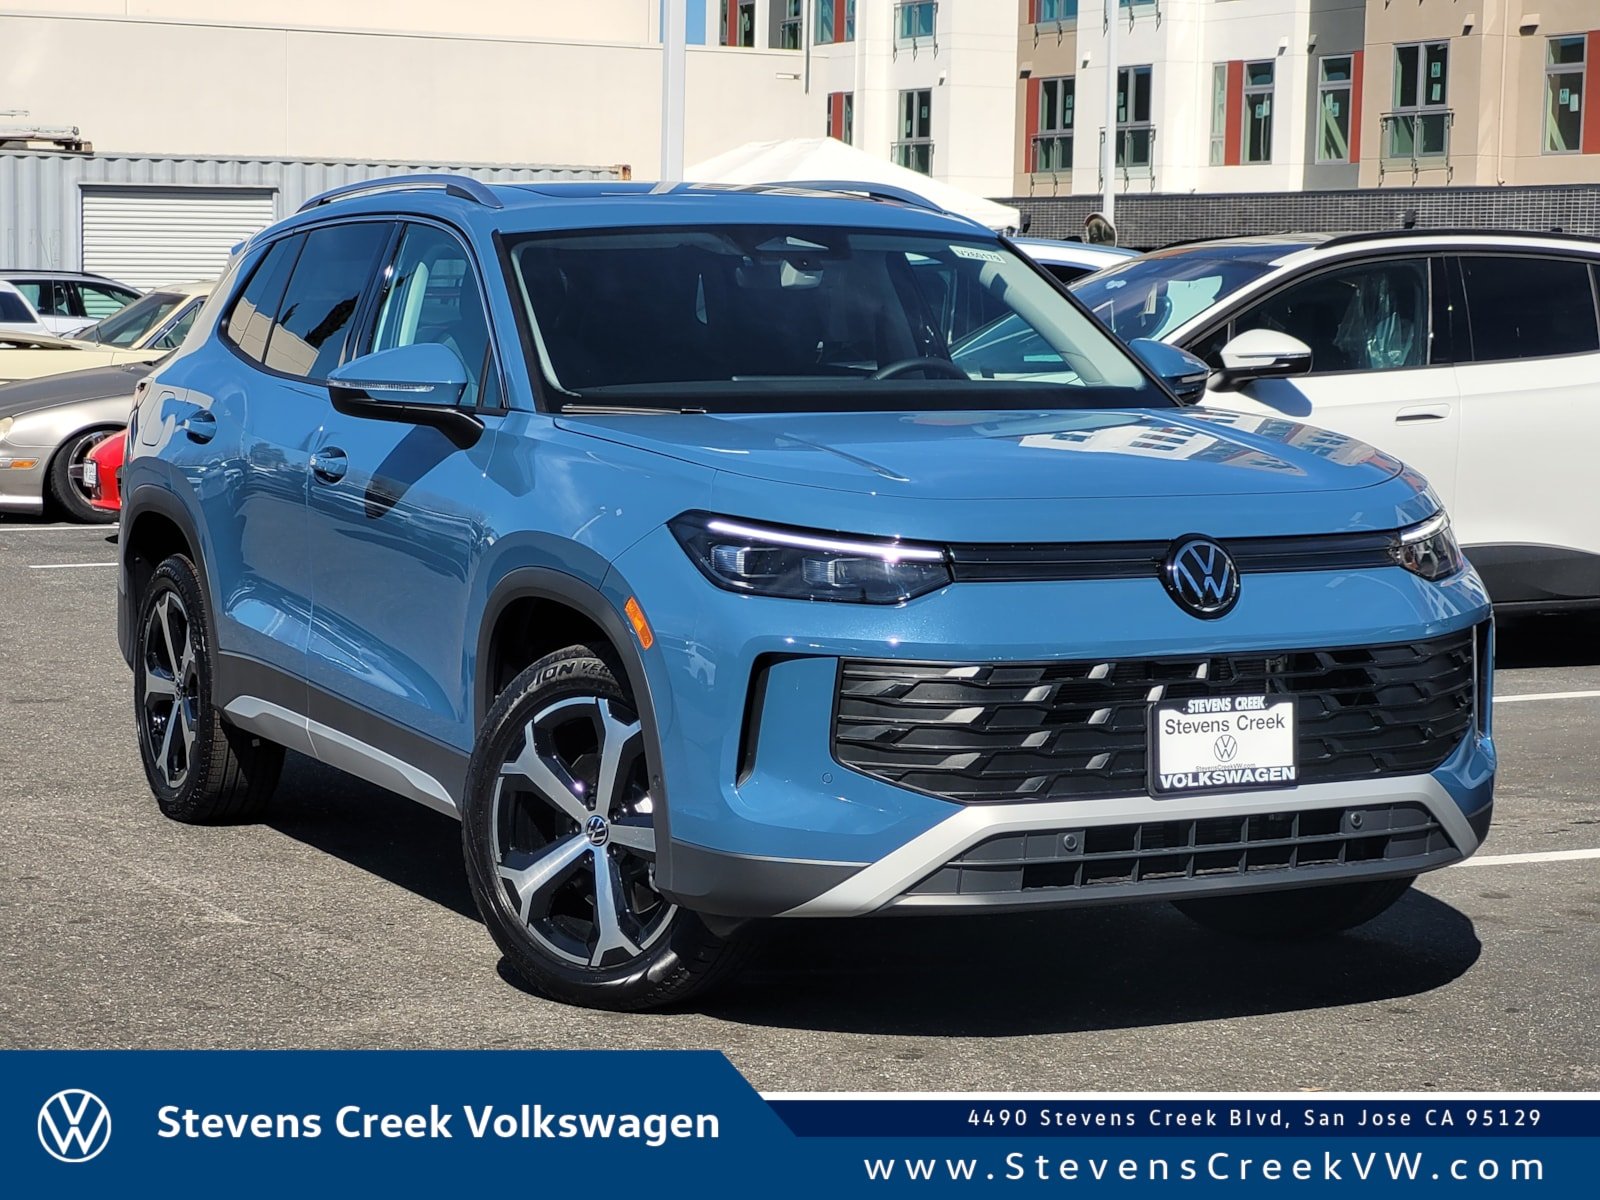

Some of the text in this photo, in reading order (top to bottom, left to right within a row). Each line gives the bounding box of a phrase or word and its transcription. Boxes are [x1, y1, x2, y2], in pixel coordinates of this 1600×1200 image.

[1187, 696, 1265, 713] STEVENS CREEK
[1164, 713, 1285, 735] Stevens Creek
[1160, 766, 1296, 788] VOLKSWAGEN
